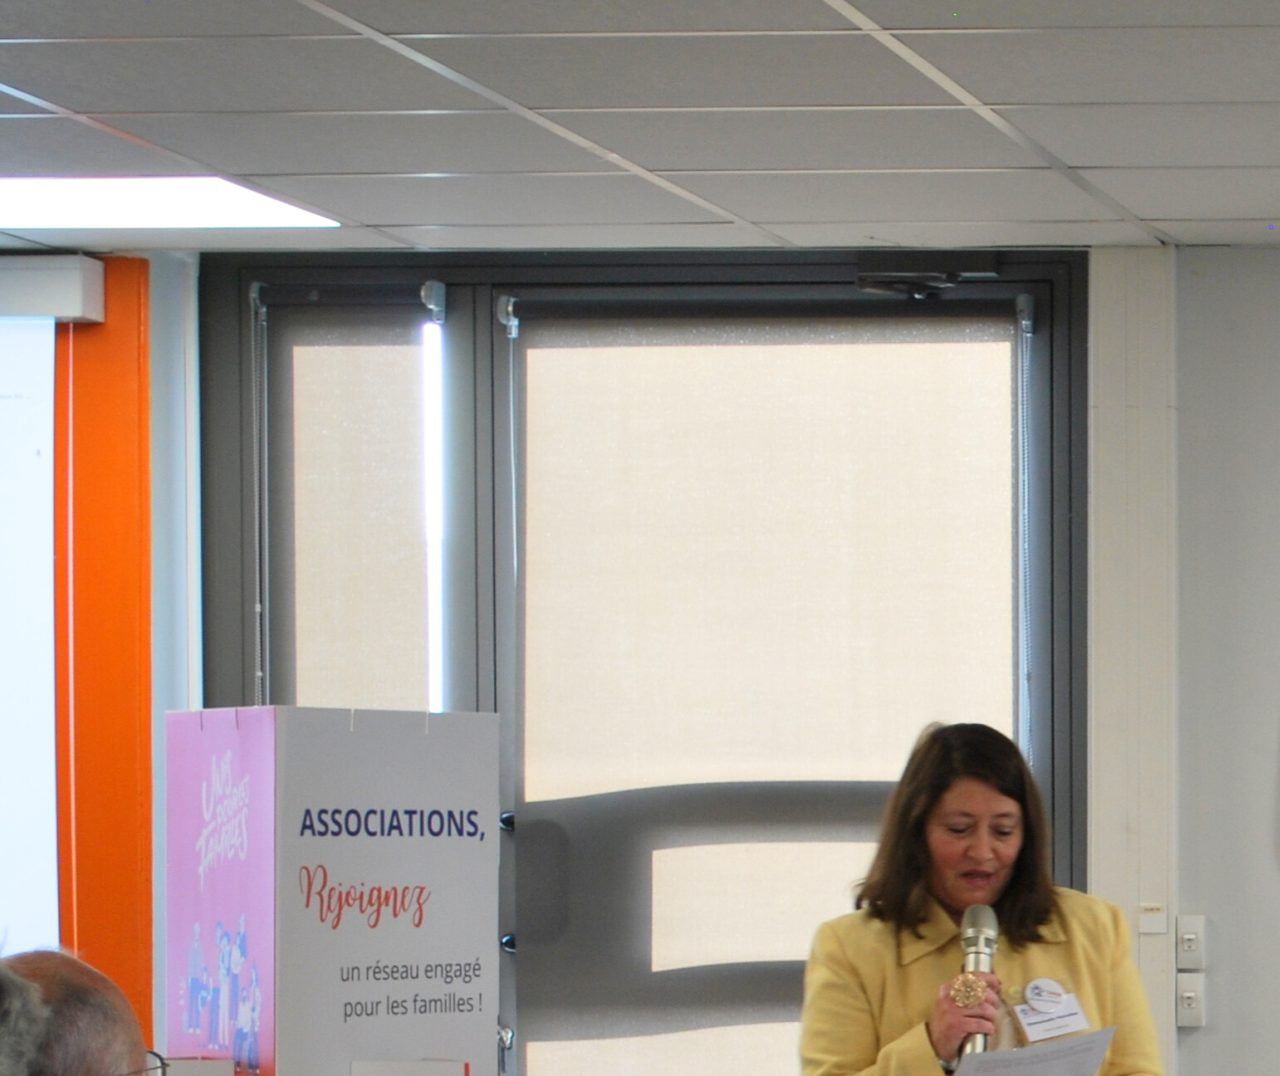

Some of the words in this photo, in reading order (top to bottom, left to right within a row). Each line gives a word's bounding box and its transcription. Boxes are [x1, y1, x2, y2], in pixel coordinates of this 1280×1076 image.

[300, 808, 486, 842] ASSOCIATIONS,
[299, 864, 431, 930] Rejoignez
[340, 965, 361, 982] un
[366, 960, 419, 981] réseau
[424, 957, 482, 984] engagé
[344, 1000, 382, 1024] pour
[386, 995, 409, 1016] les
[413, 993, 474, 1015] familles
